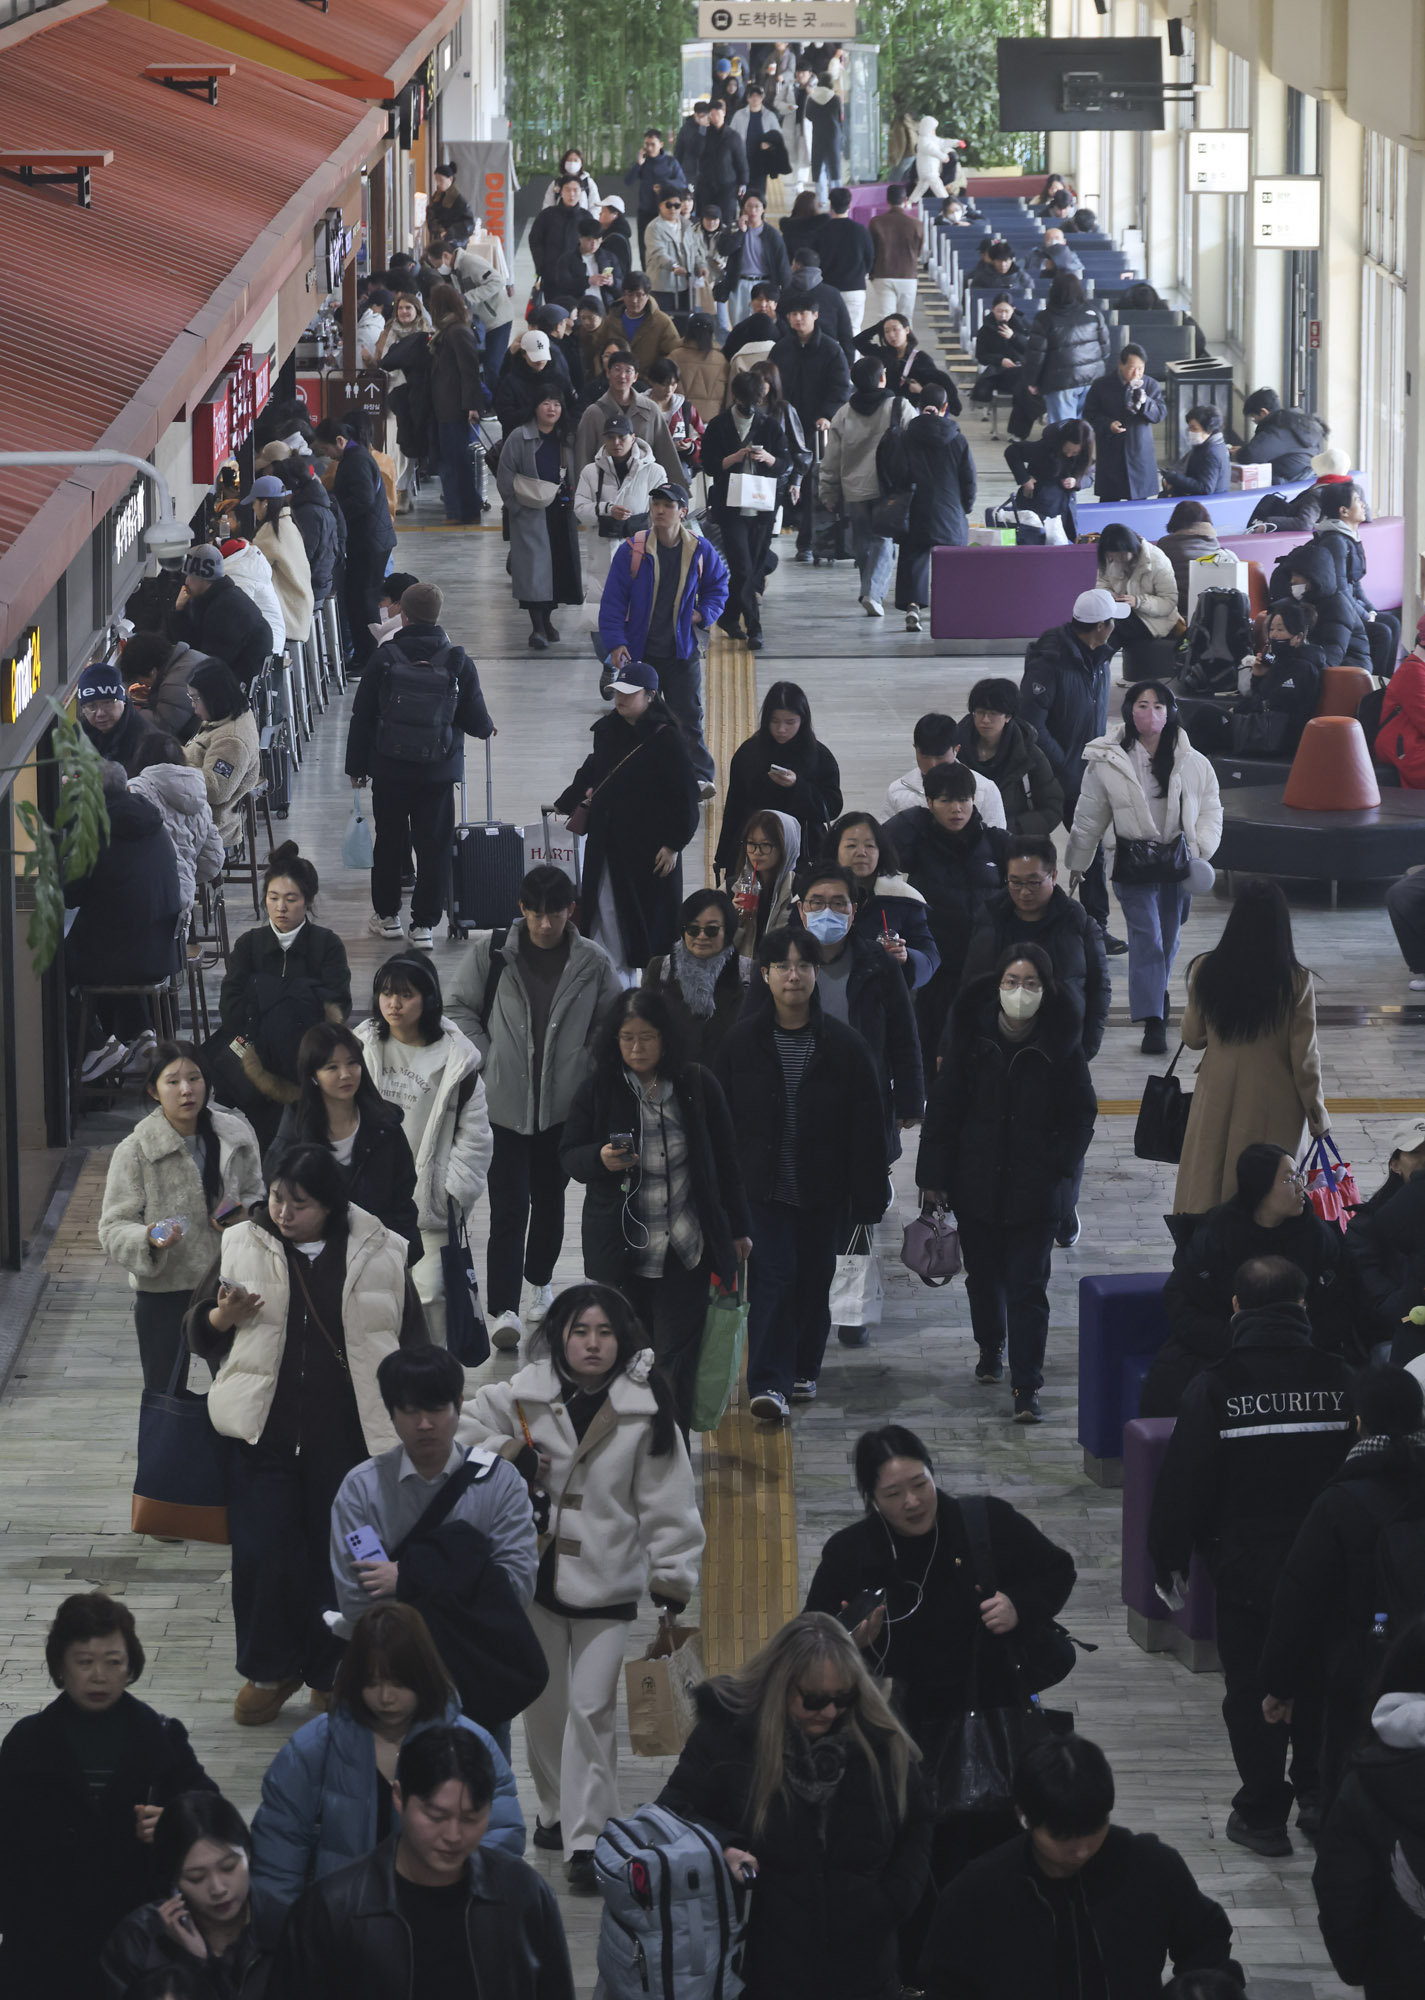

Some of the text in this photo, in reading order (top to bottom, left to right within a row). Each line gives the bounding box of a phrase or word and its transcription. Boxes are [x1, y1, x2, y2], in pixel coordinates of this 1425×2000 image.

[737, 12, 817, 28] 도착하는 곳
[1226, 1391, 1345, 1418] SECURITY
